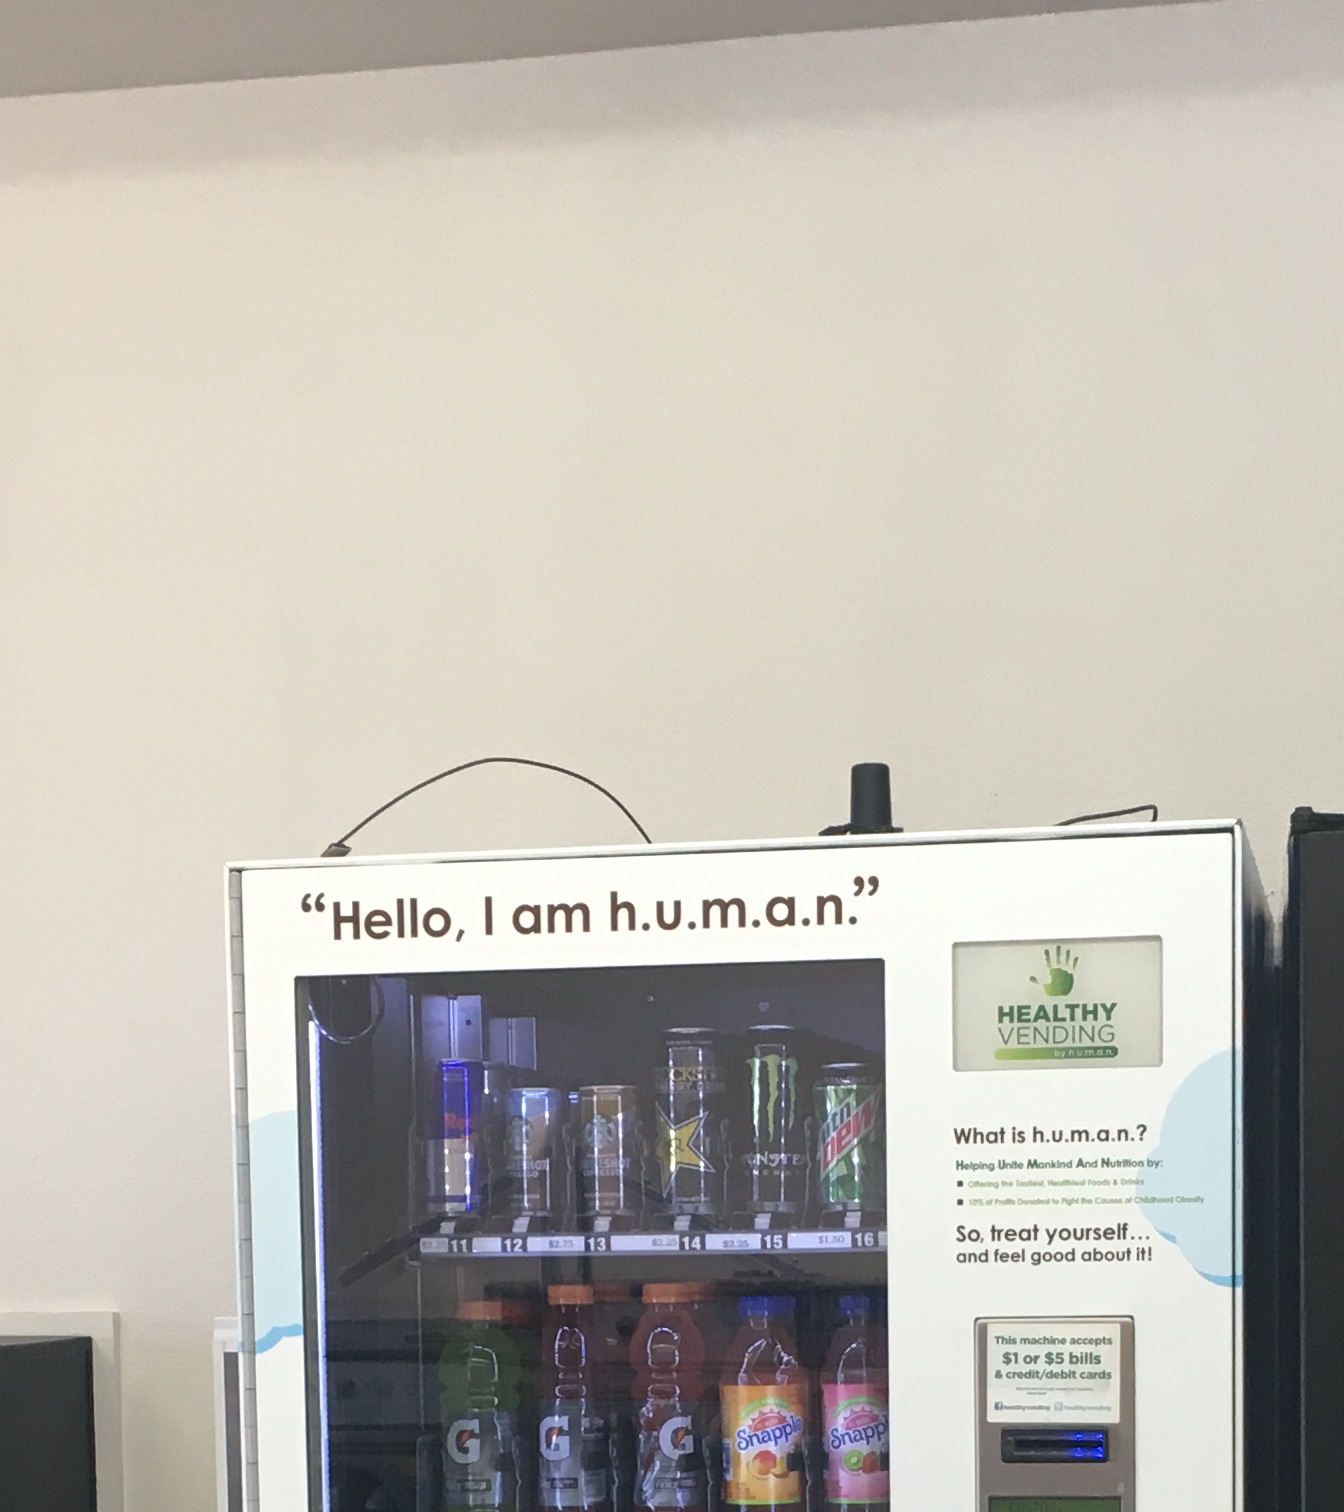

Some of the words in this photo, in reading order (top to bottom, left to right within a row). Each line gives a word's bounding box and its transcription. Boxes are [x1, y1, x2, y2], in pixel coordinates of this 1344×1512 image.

[484, 896, 494, 936] I
[512, 901, 591, 934] am
[997, 1002, 1117, 1024] HEALTHY
[997, 1024, 1115, 1045] VENDING
[1054, 1049, 1066, 1058] by
[954, 1127, 1006, 1144] What
[1012, 1127, 1026, 1144] is
[1033, 1124, 1147, 1143] h.u.m.a.n.?
[956, 1159, 995, 1172] Helping
[998, 1160, 1024, 1170] Unite
[1027, 1159, 1073, 1169] Mankind
[1075, 1158, 1098, 1169] And
[1101, 1158, 1144, 1169] Nutrition
[1146, 1158, 1163, 1169] by:
[763, 1234, 784, 1250] 15
[854, 1231, 874, 1247] 16
[956, 1225, 984, 1244] So,
[990, 1225, 1039, 1242] treat
[681, 1235, 702, 1251] 14
[956, 1249, 989, 1263] and
[994, 1248, 1026, 1263] feel
[1030, 1248, 1076, 1266] good
[1081, 1248, 1131, 1262] about
[1136, 1247, 1152, 1261] it!
[994, 1335, 1017, 1345] This
[1019, 1336, 1067, 1345] machine
[1069, 1336, 1113, 1347] accepts
[1002, 1351, 1019, 1366] $1
[1023, 1354, 1040, 1365] or
[1044, 1351, 1064, 1366] $5
[1069, 1352, 1101, 1365] bills
[994, 1370, 1003, 1379] &
[1005, 1369, 1077, 1380] credit/debit
[1080, 1369, 1112, 1379] cards
[736, 1414, 802, 1451] Snapple
